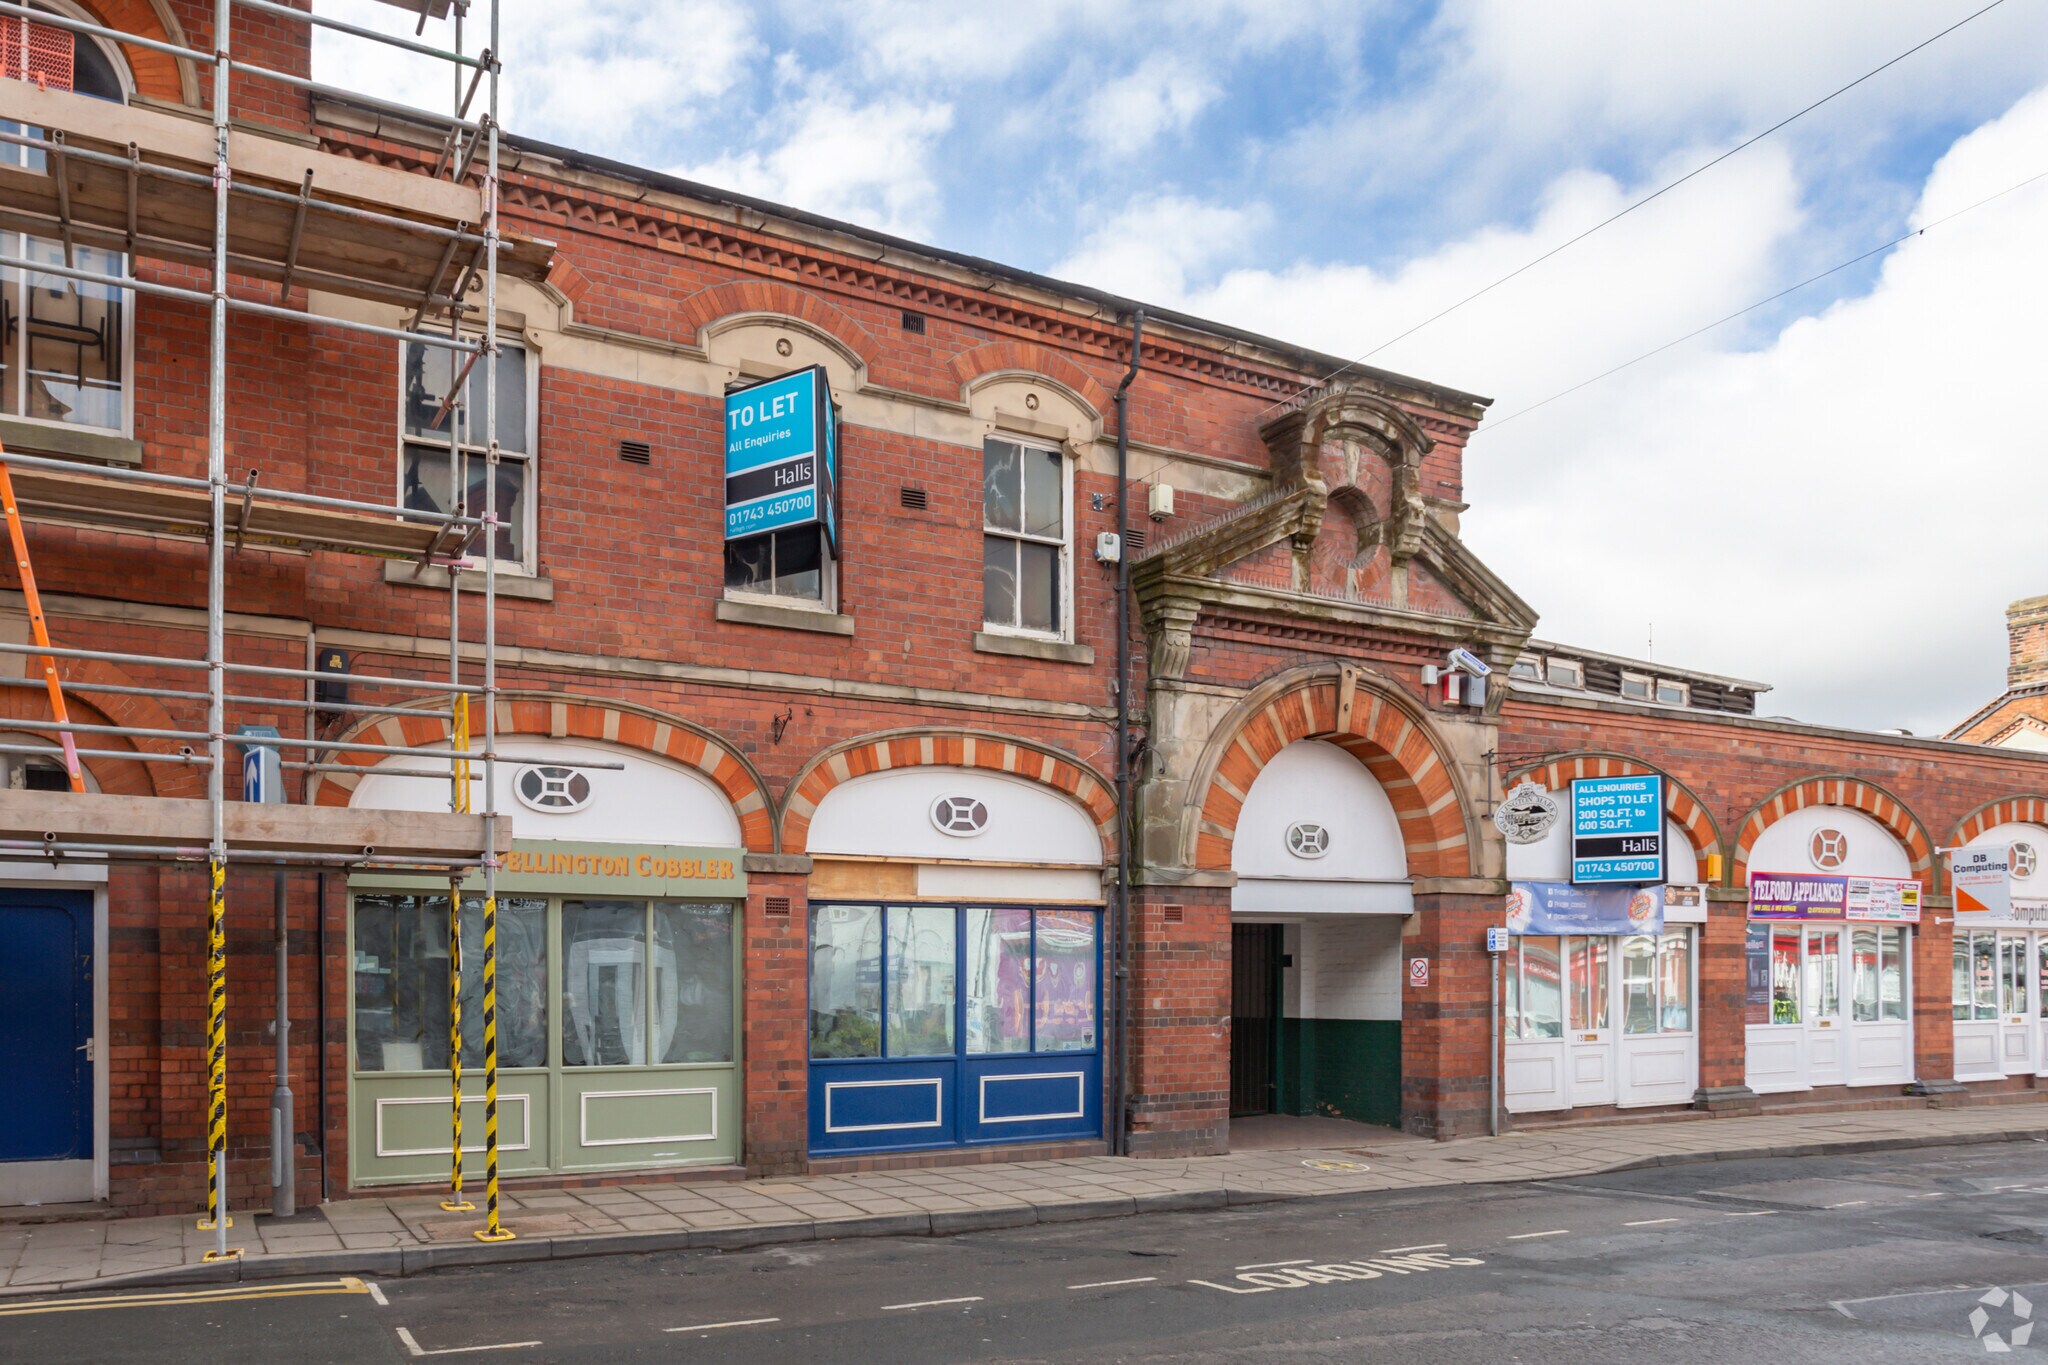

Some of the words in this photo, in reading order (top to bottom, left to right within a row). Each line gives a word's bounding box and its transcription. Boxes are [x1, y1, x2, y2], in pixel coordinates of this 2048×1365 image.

[729, 405, 754, 430] TO
[759, 391, 799, 422] LET
[729, 442, 742, 453] All
[744, 428, 792, 449] Enquiries
[774, 463, 811, 487] Halls
[729, 505, 764, 526] 01743
[767, 494, 812, 516] 450700
[1578, 785, 1596, 794] ALL
[1597, 782, 1646, 793] ENQUIRIES
[1578, 796, 1615, 807] SHOPS
[1617, 795, 1632, 805] TO
[1633, 793, 1654, 804] LET
[1578, 810, 1598, 820] 300
[1599, 807, 1633, 819] SQ.FT.
[1634, 808, 1646, 817] to
[1578, 821, 1598, 831] 600
[1599, 819, 1633, 830] SQ.FT.
[1622, 839, 1657, 853] Halls
[1973, 854, 1987, 863] DB
[634, 853, 735, 880] COBBLER
[1577, 864, 1612, 874] 01743
[1613, 861, 1655, 872] 450700
[1953, 862, 2008, 874] Computing
[1754, 880, 1793, 902] TELFORD
[1792, 881, 1844, 903] APPLIANCES
[1187, 1253, 1485, 1294] LOADING
